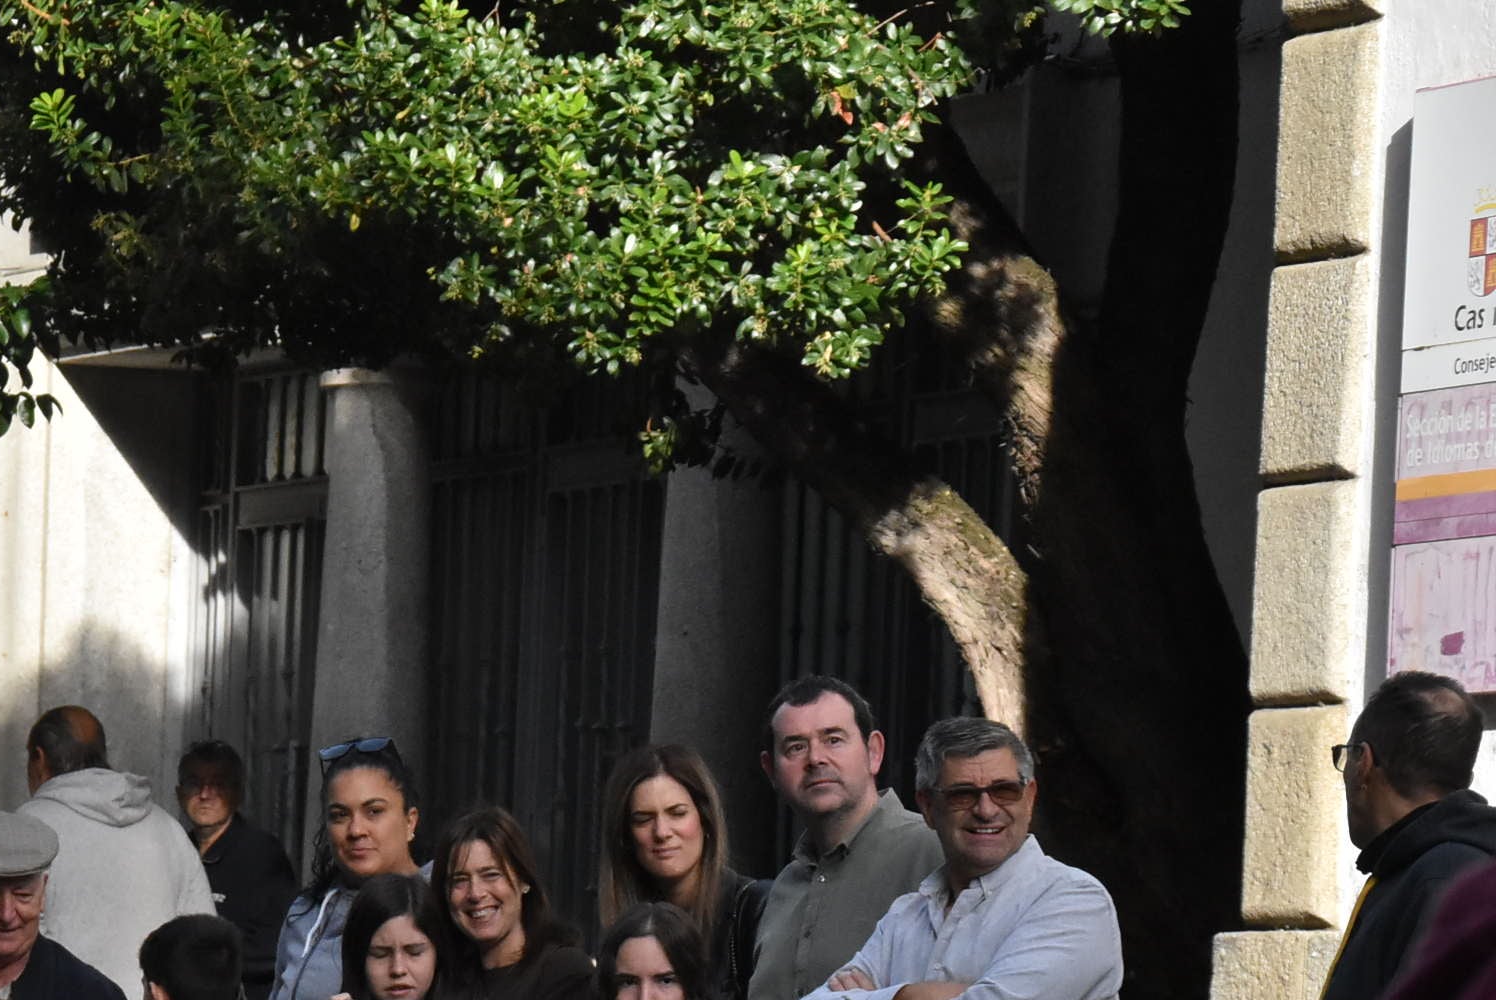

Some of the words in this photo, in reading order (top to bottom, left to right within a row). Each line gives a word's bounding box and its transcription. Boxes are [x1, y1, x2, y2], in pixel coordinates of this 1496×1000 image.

[1406, 409, 1454, 439] Sección
[1457, 408, 1473, 431] de
[1475, 405, 1487, 430] la
[1407, 440, 1424, 467] de
[1427, 439, 1480, 464] Idiomas
